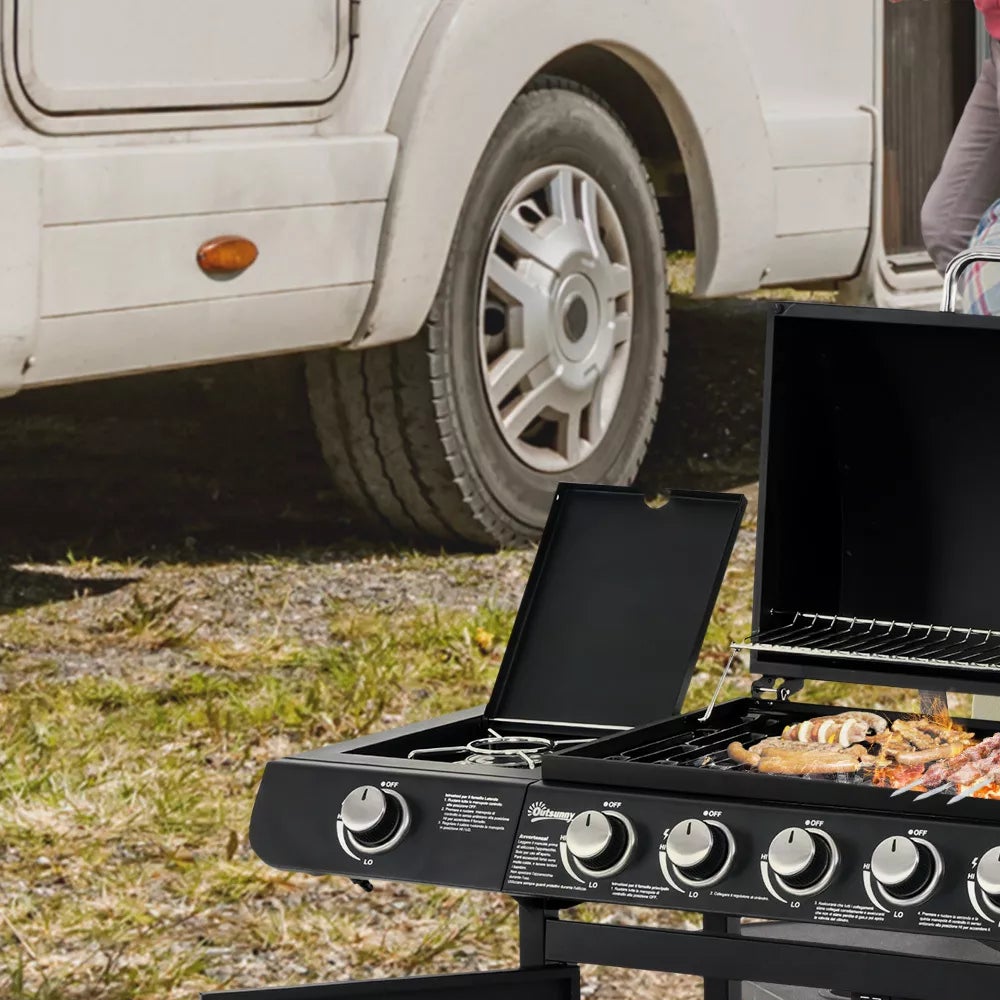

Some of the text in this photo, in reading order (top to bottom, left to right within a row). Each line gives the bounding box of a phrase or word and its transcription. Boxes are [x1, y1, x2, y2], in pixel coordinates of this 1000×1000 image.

[532, 807, 576, 823] Outsunny
[709, 810, 723, 818] OFF
[810, 819, 824, 827] OFF
[588, 881, 598, 889] LO
